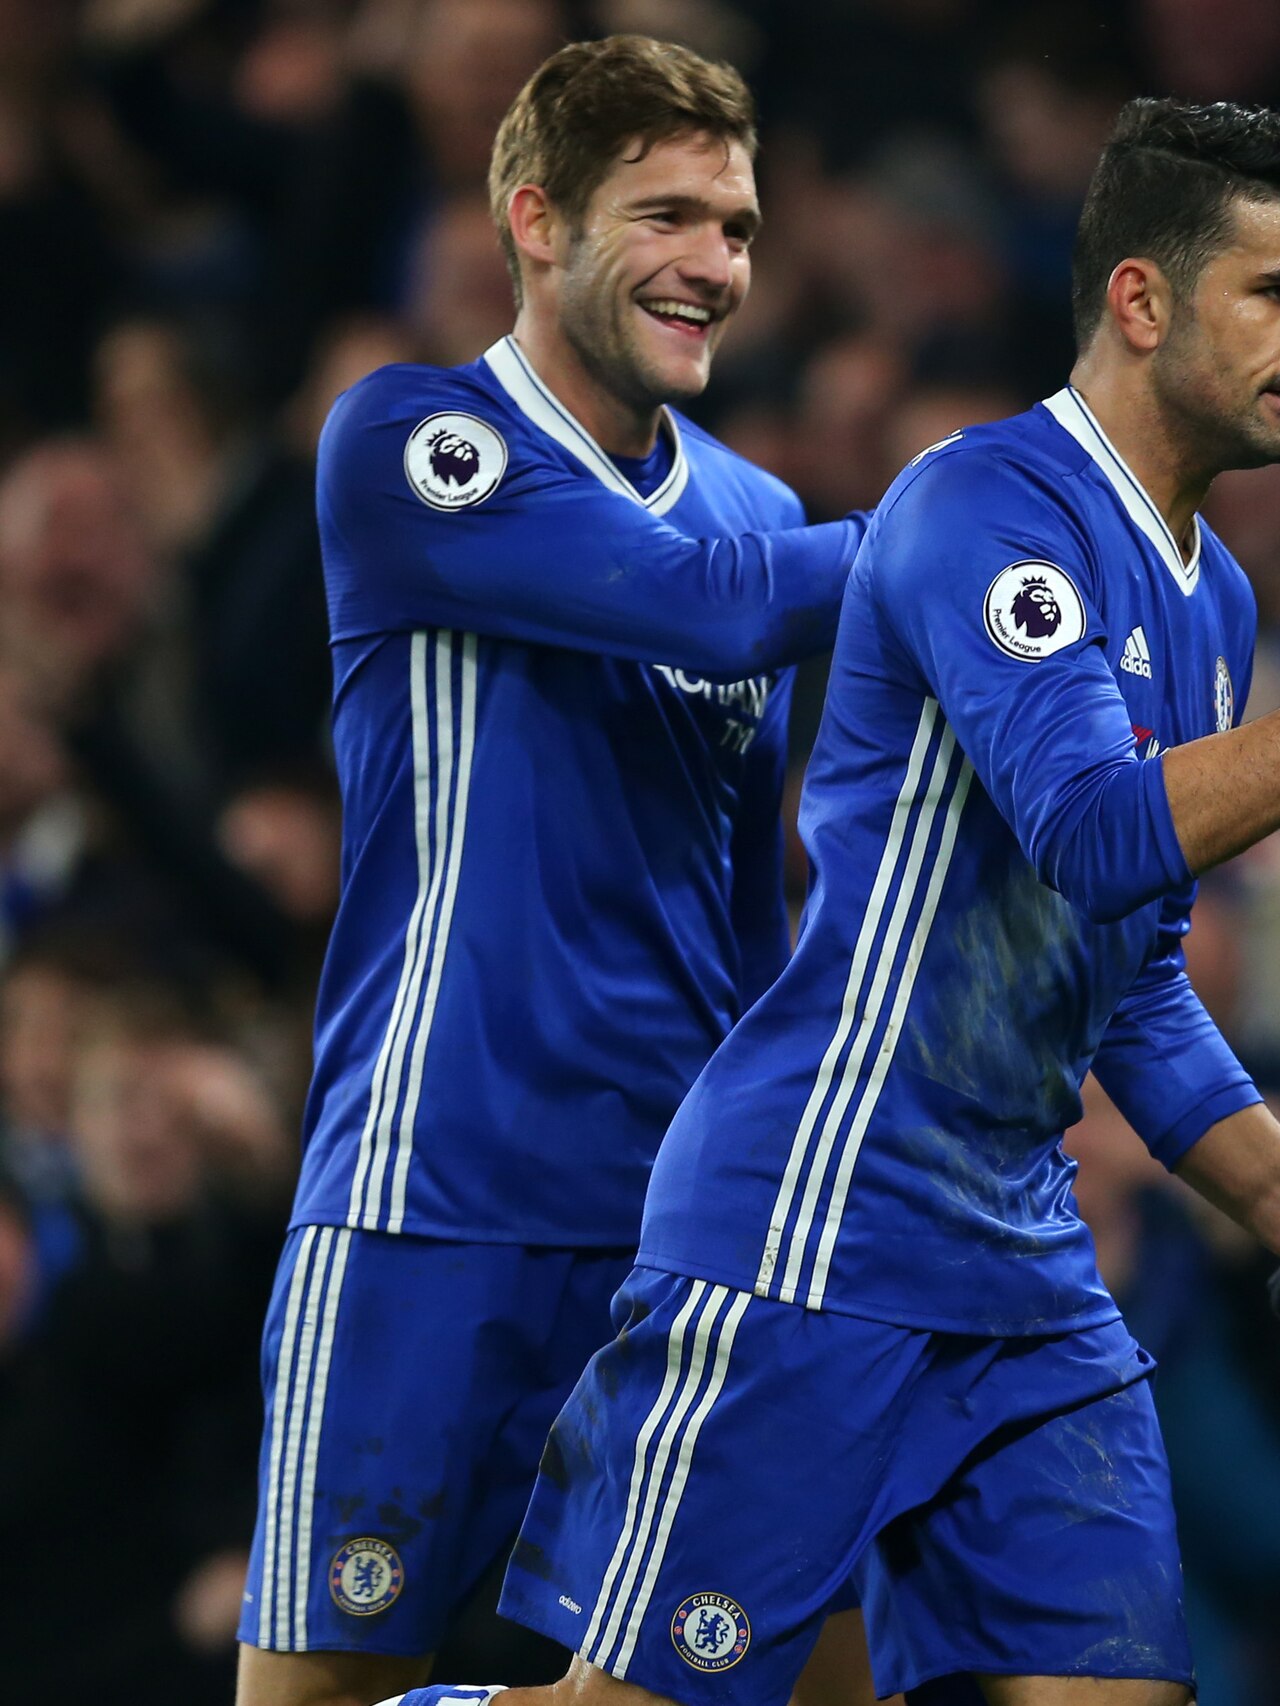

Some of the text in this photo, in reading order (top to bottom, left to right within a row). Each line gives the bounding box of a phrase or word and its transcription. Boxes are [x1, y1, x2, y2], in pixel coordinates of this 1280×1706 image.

[447, 487, 479, 502] League
[993, 608, 1042, 654] Premier League
[692, 1595, 742, 1620] CHELSEA
[679, 1644, 730, 1668] FOOTBALL CLUB
